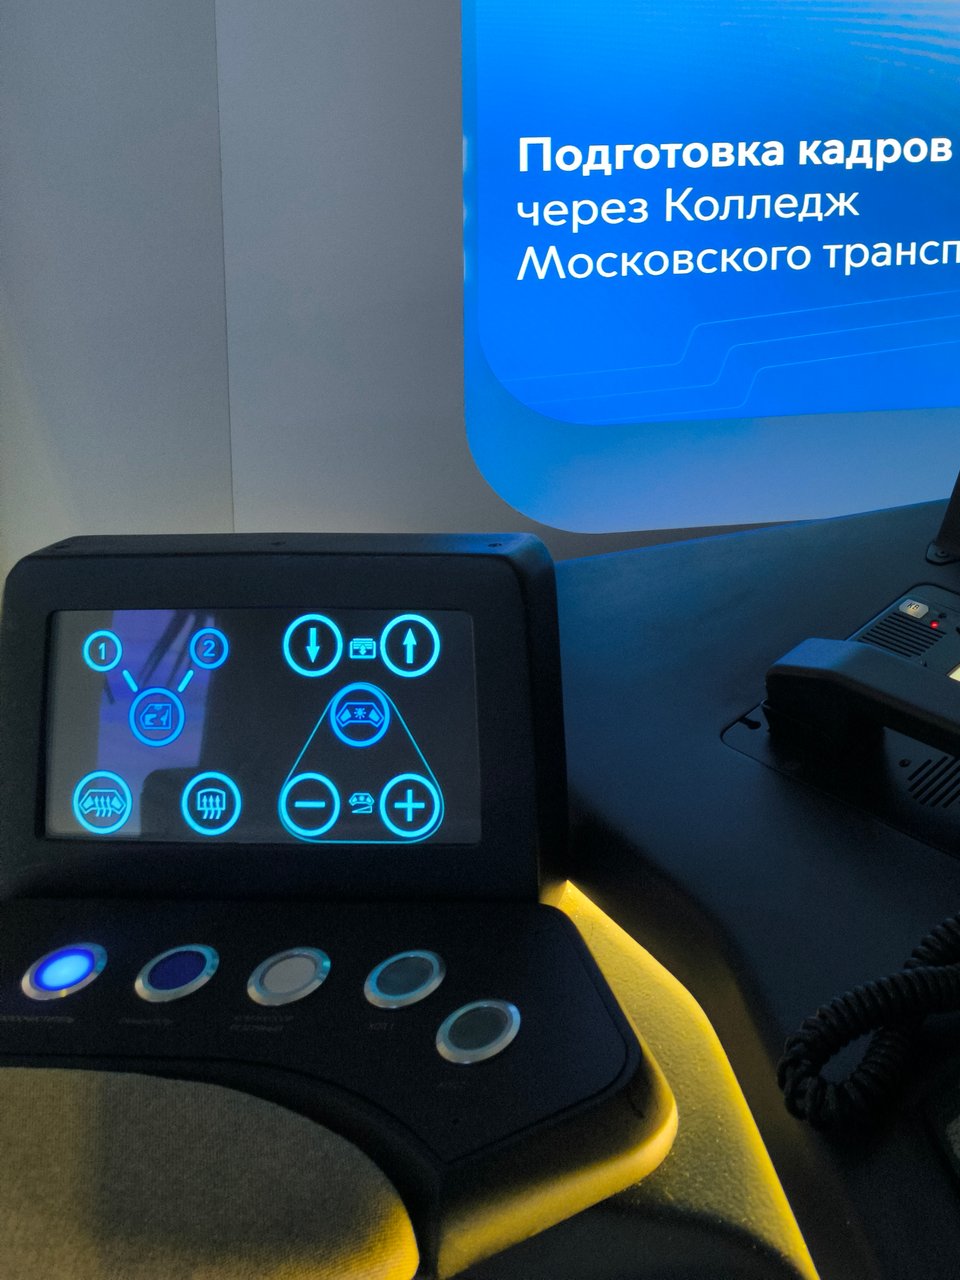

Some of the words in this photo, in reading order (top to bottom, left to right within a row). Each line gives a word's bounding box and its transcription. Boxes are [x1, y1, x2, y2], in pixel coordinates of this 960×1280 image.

[517, 136, 786, 175] Подготовка
[799, 136, 953, 172] кадров
[516, 196, 649, 233] через
[664, 187, 860, 222] Колледж
[516, 244, 812, 281] Московского
[97, 642, 108, 660] 1
[202, 639, 216, 658] 2
